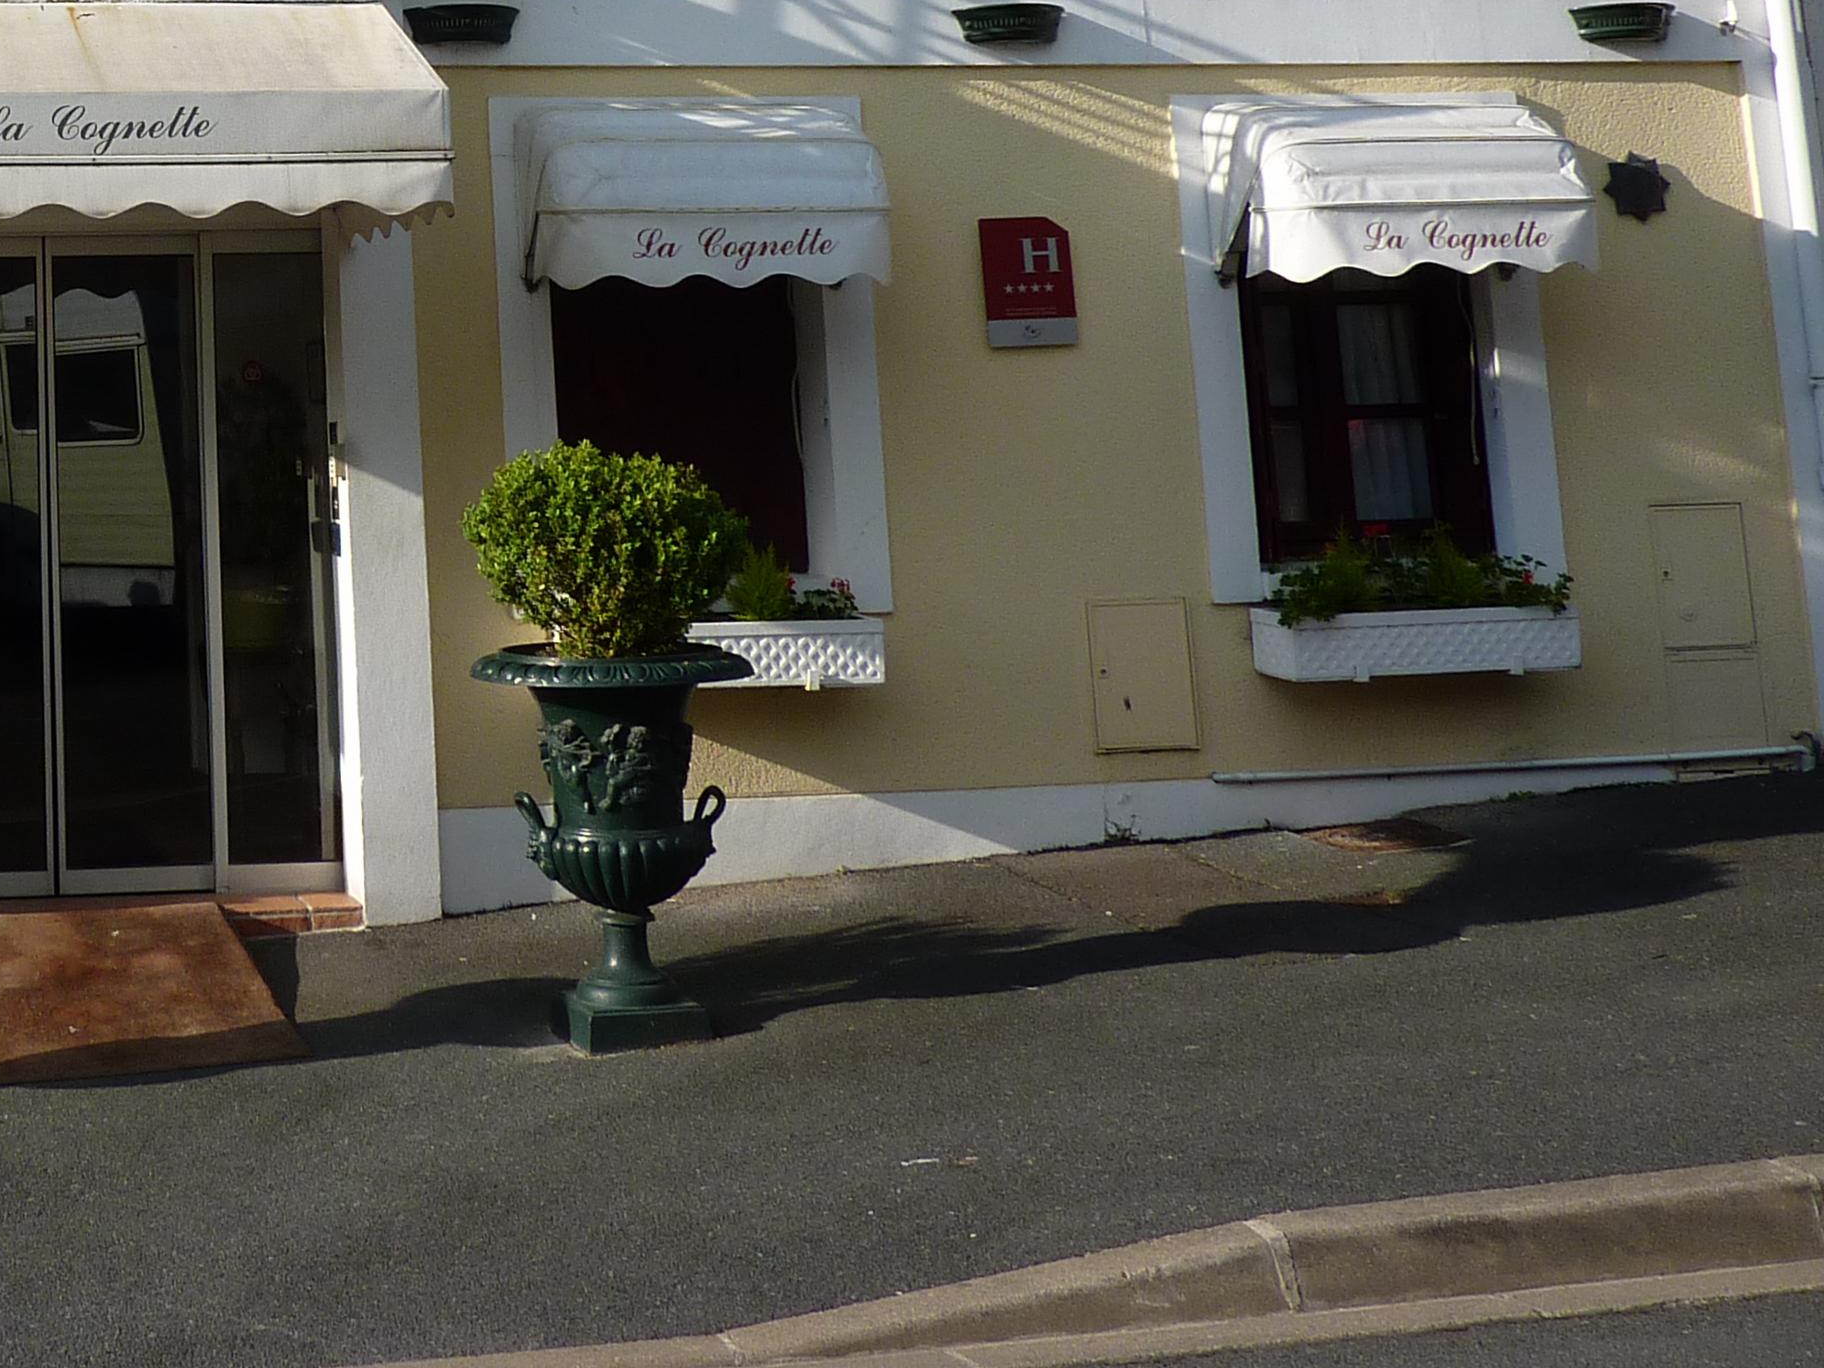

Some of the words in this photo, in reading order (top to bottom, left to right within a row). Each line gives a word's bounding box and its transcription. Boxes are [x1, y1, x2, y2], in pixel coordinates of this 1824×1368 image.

[51, 104, 219, 156] Cognette
[632, 227, 684, 259] La
[697, 226, 839, 271] Cognette
[1018, 236, 1063, 274] H
[1363, 221, 1409, 252] La
[1422, 220, 1553, 262] Cognette
